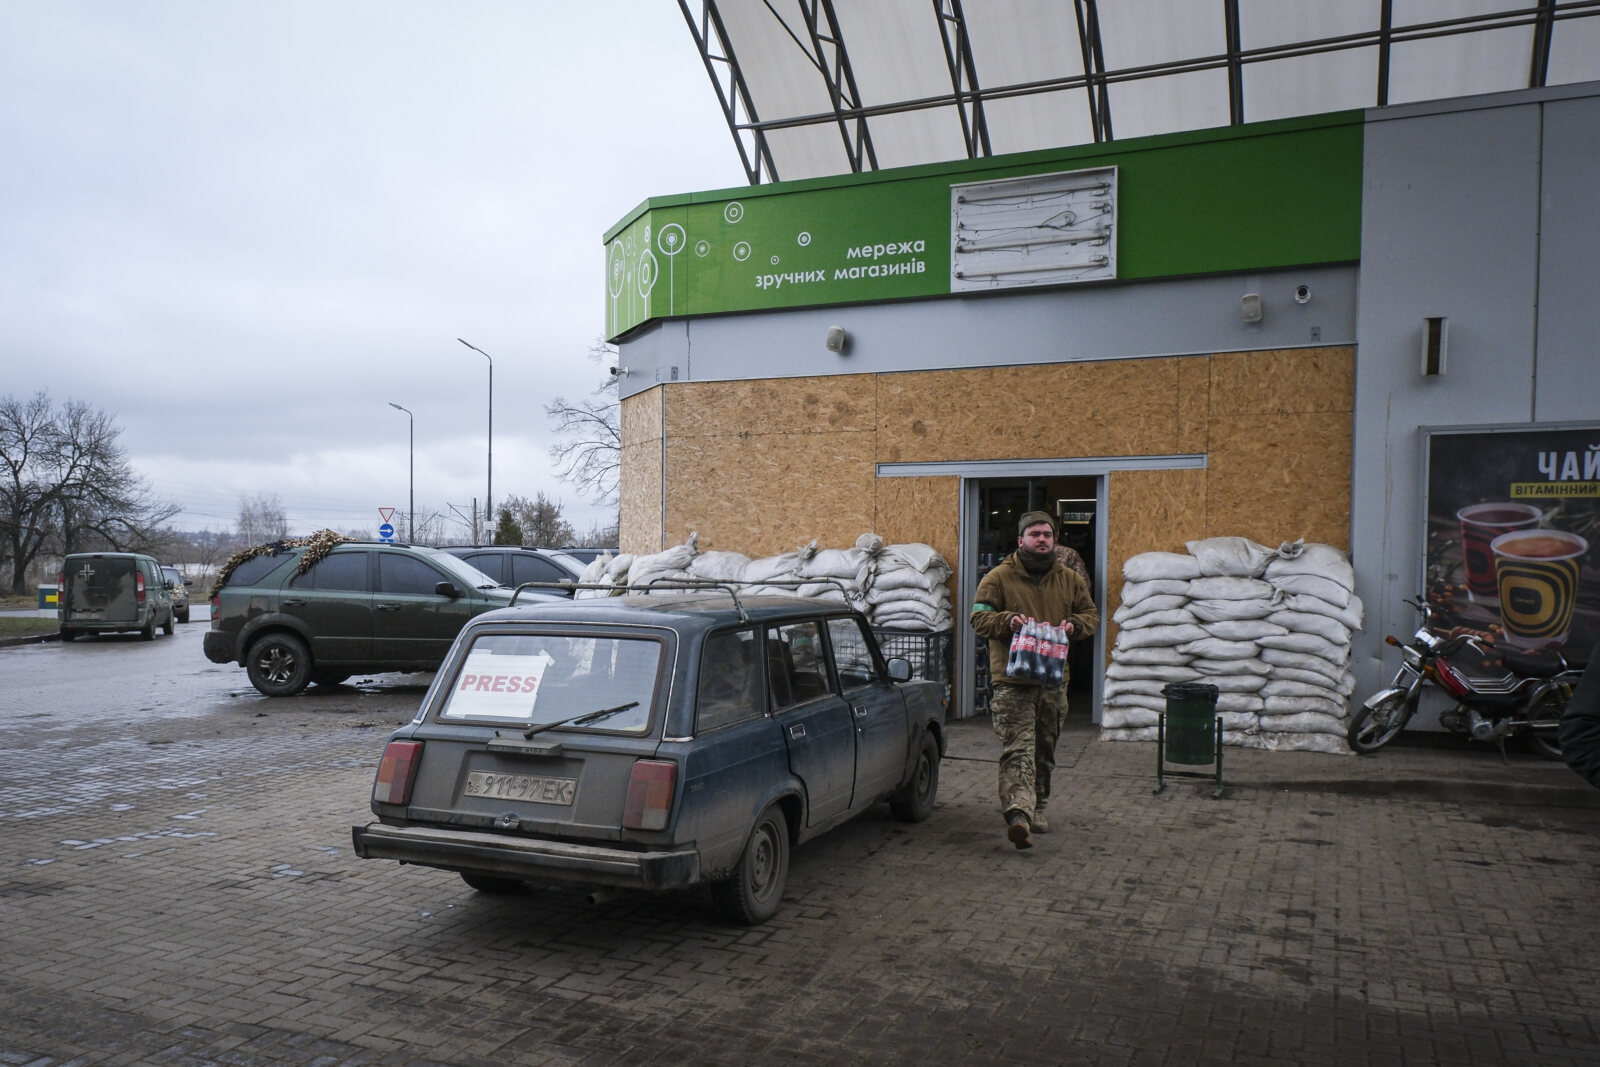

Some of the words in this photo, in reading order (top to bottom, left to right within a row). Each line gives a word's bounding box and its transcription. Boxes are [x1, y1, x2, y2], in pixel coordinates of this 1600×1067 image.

[847, 240, 925, 259] мережа
[755, 269, 826, 290] зручних
[834, 258, 926, 280] магазинів
[1538, 443, 1600, 481] ЧАЙ
[1515, 483, 1597, 496] ВІТАМІННИЙ
[460, 674, 537, 693] PRESS
